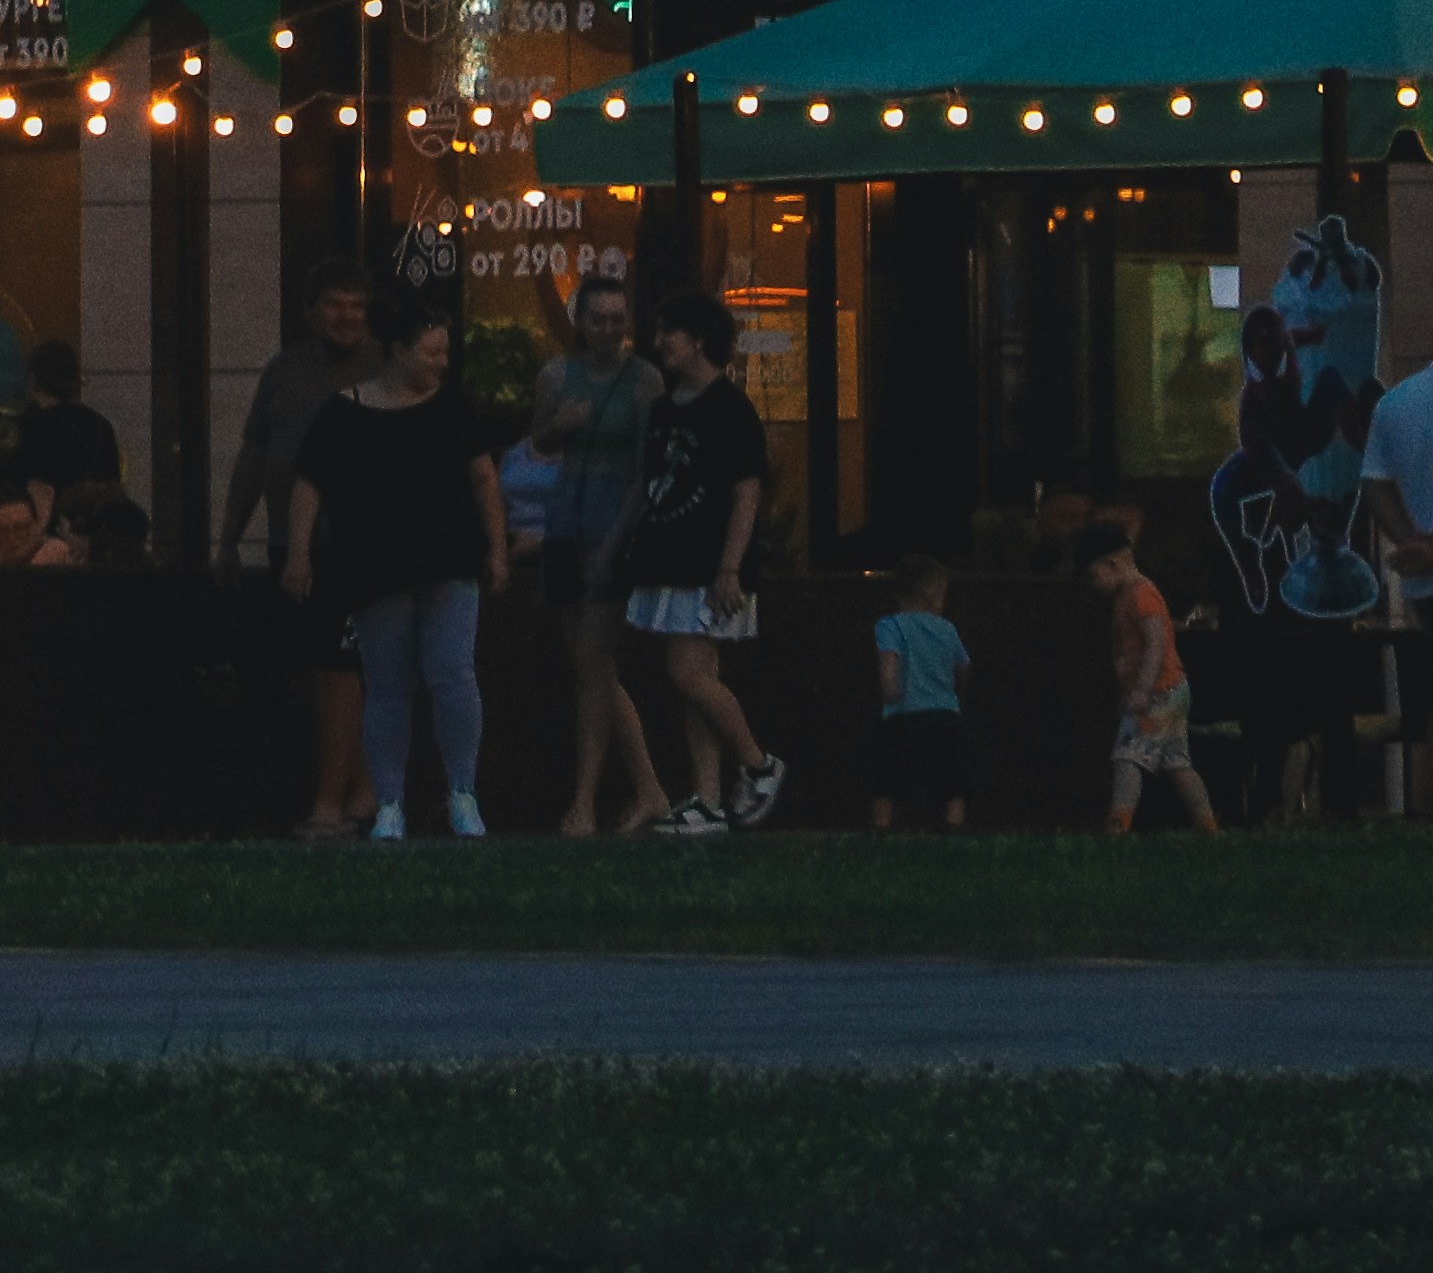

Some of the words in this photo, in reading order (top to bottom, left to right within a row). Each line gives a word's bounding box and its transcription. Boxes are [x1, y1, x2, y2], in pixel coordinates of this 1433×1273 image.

[16, 36, 68, 69] 390
[473, 198, 583, 232] РОЛЛЫ
[514, 243, 568, 277] 290
